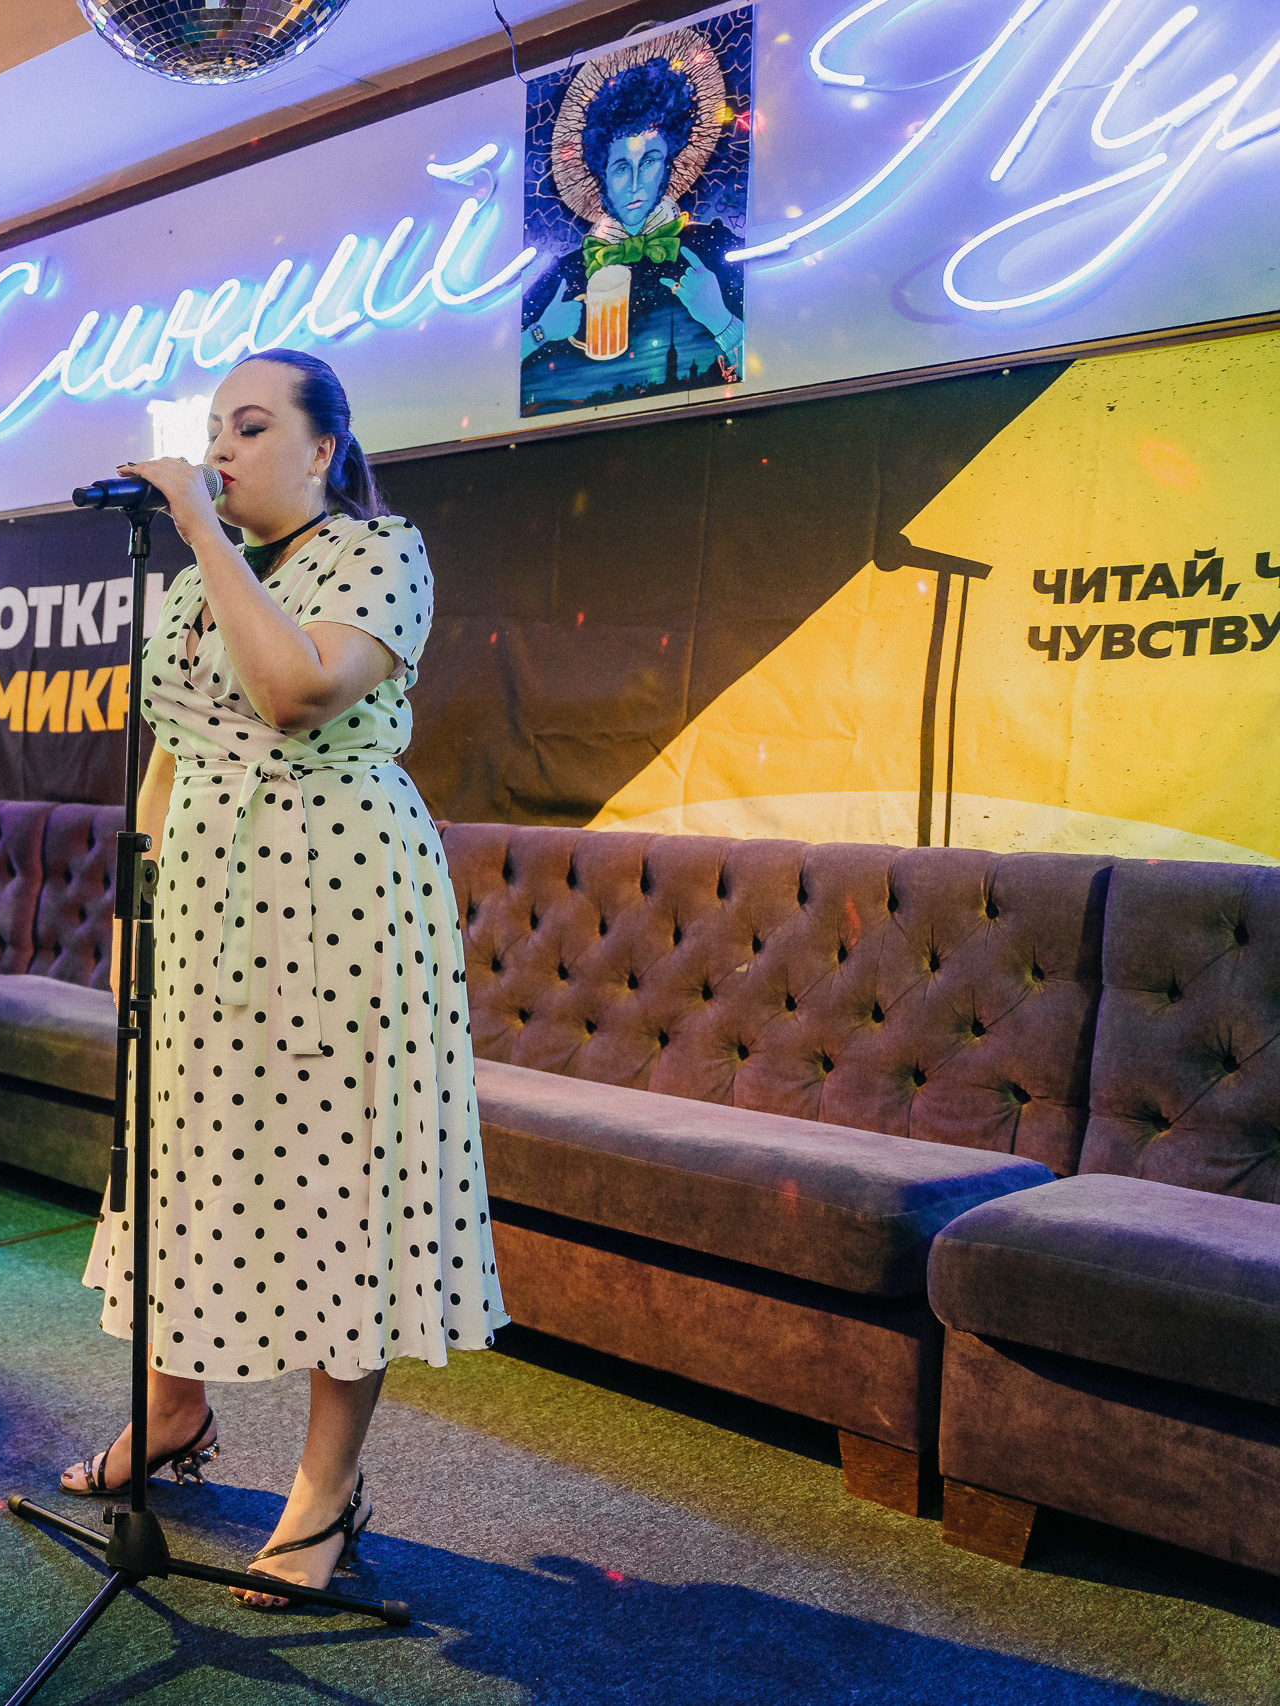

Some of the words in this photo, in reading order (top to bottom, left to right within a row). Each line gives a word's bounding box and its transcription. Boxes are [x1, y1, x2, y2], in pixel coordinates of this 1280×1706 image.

[725, 0, 1280, 310] Пу
[1033, 547, 1241, 604] ЧИТАЙ,
[1028, 610, 1280, 661] ЧУВСТВУ
